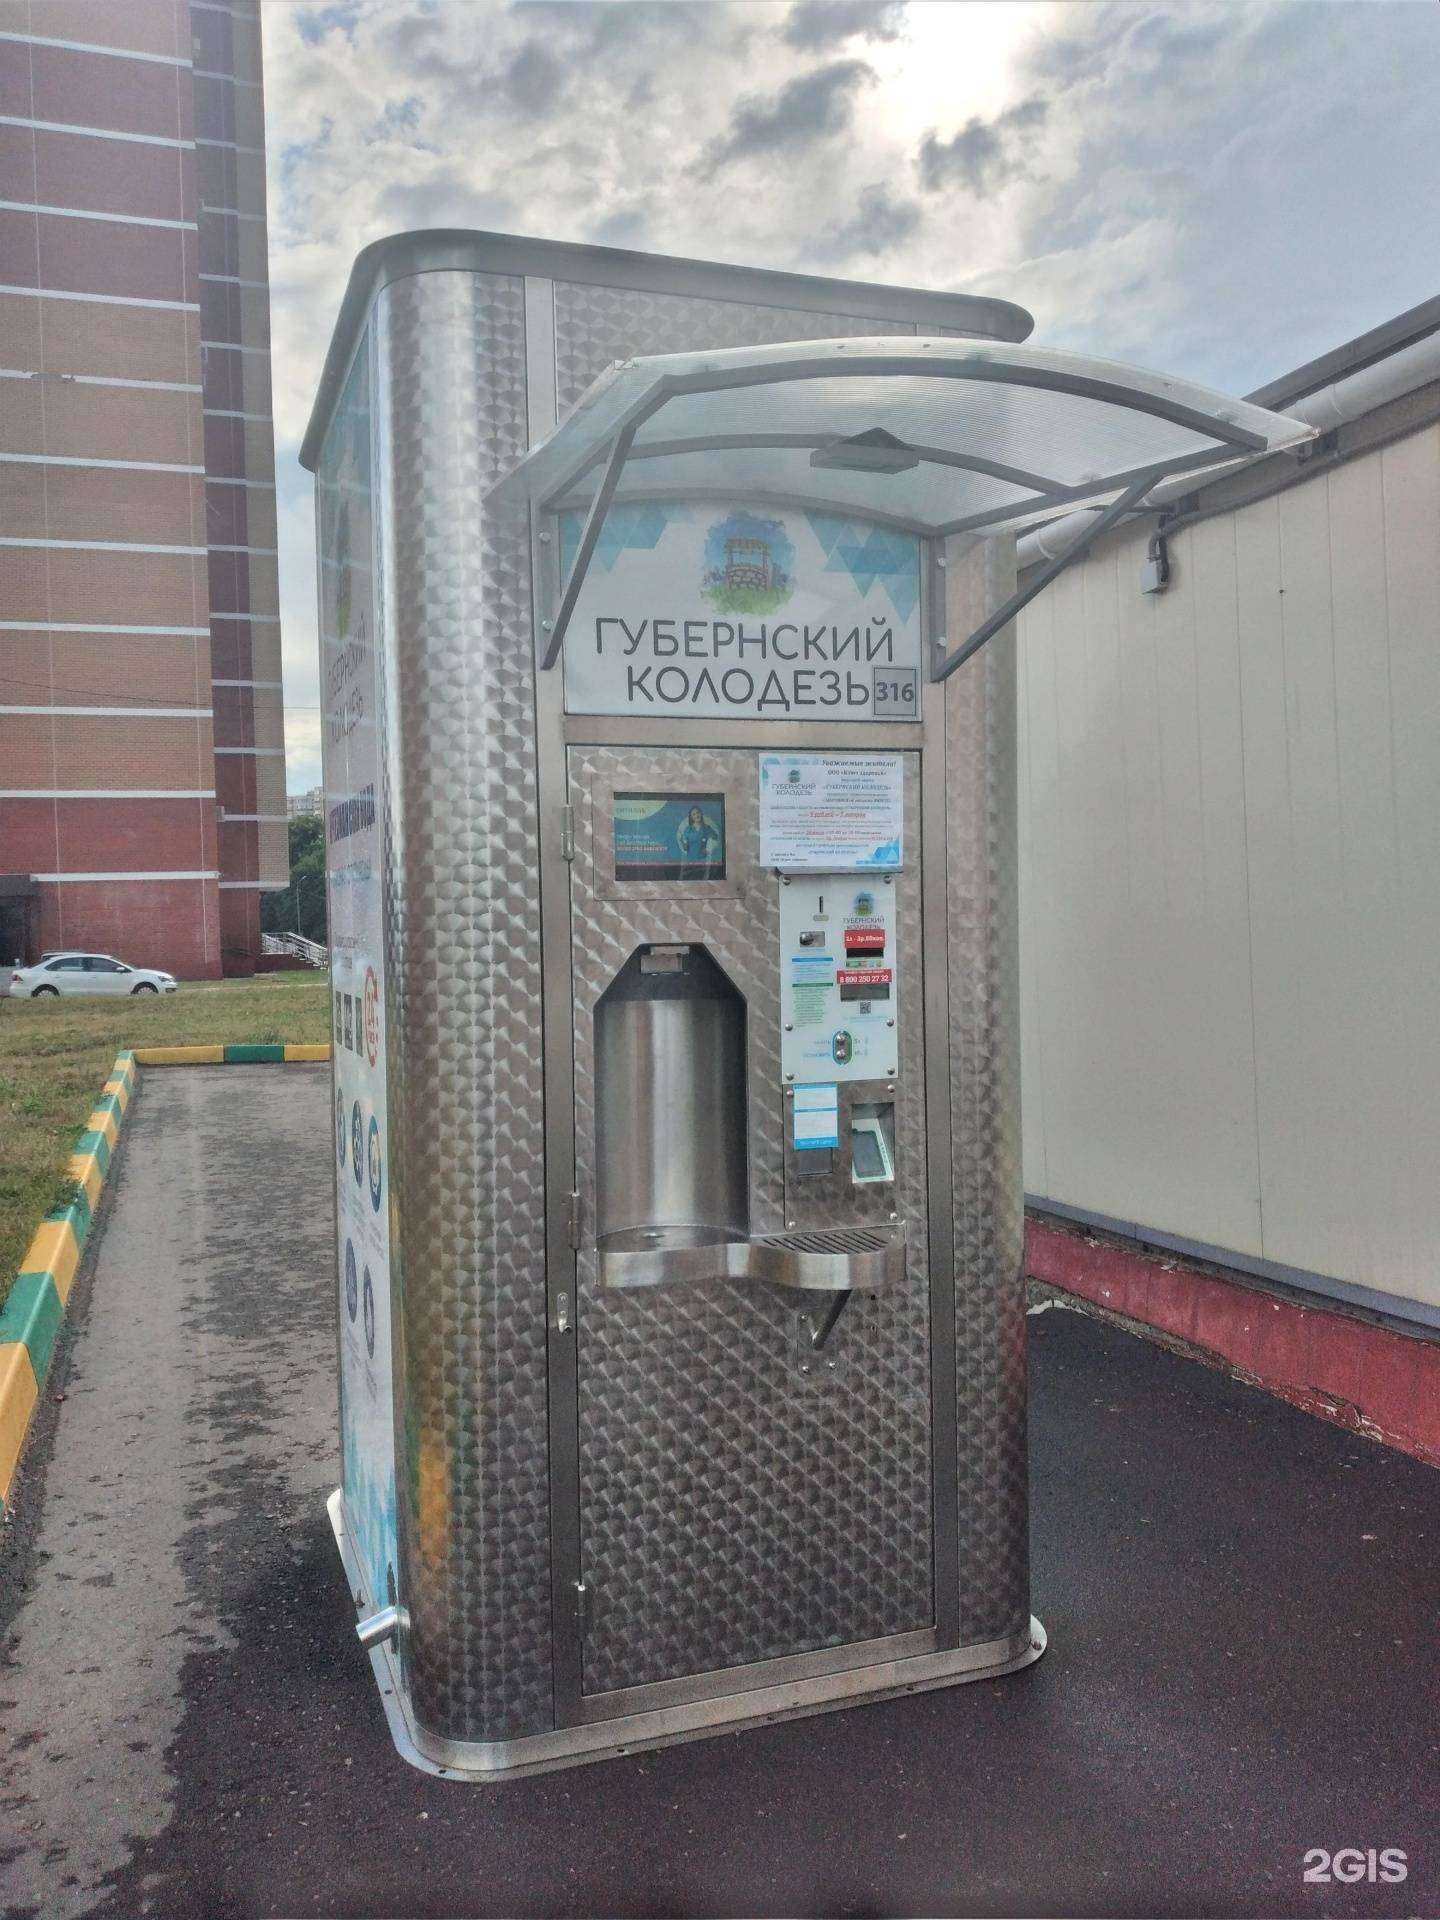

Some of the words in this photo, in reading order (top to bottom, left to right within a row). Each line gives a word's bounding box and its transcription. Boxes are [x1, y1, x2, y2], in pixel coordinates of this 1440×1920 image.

[595, 616, 894, 662] ГУБЕРНСКИЙ
[627, 665, 870, 711] КОЛОДЕЗЬ
[875, 680, 916, 703] 316
